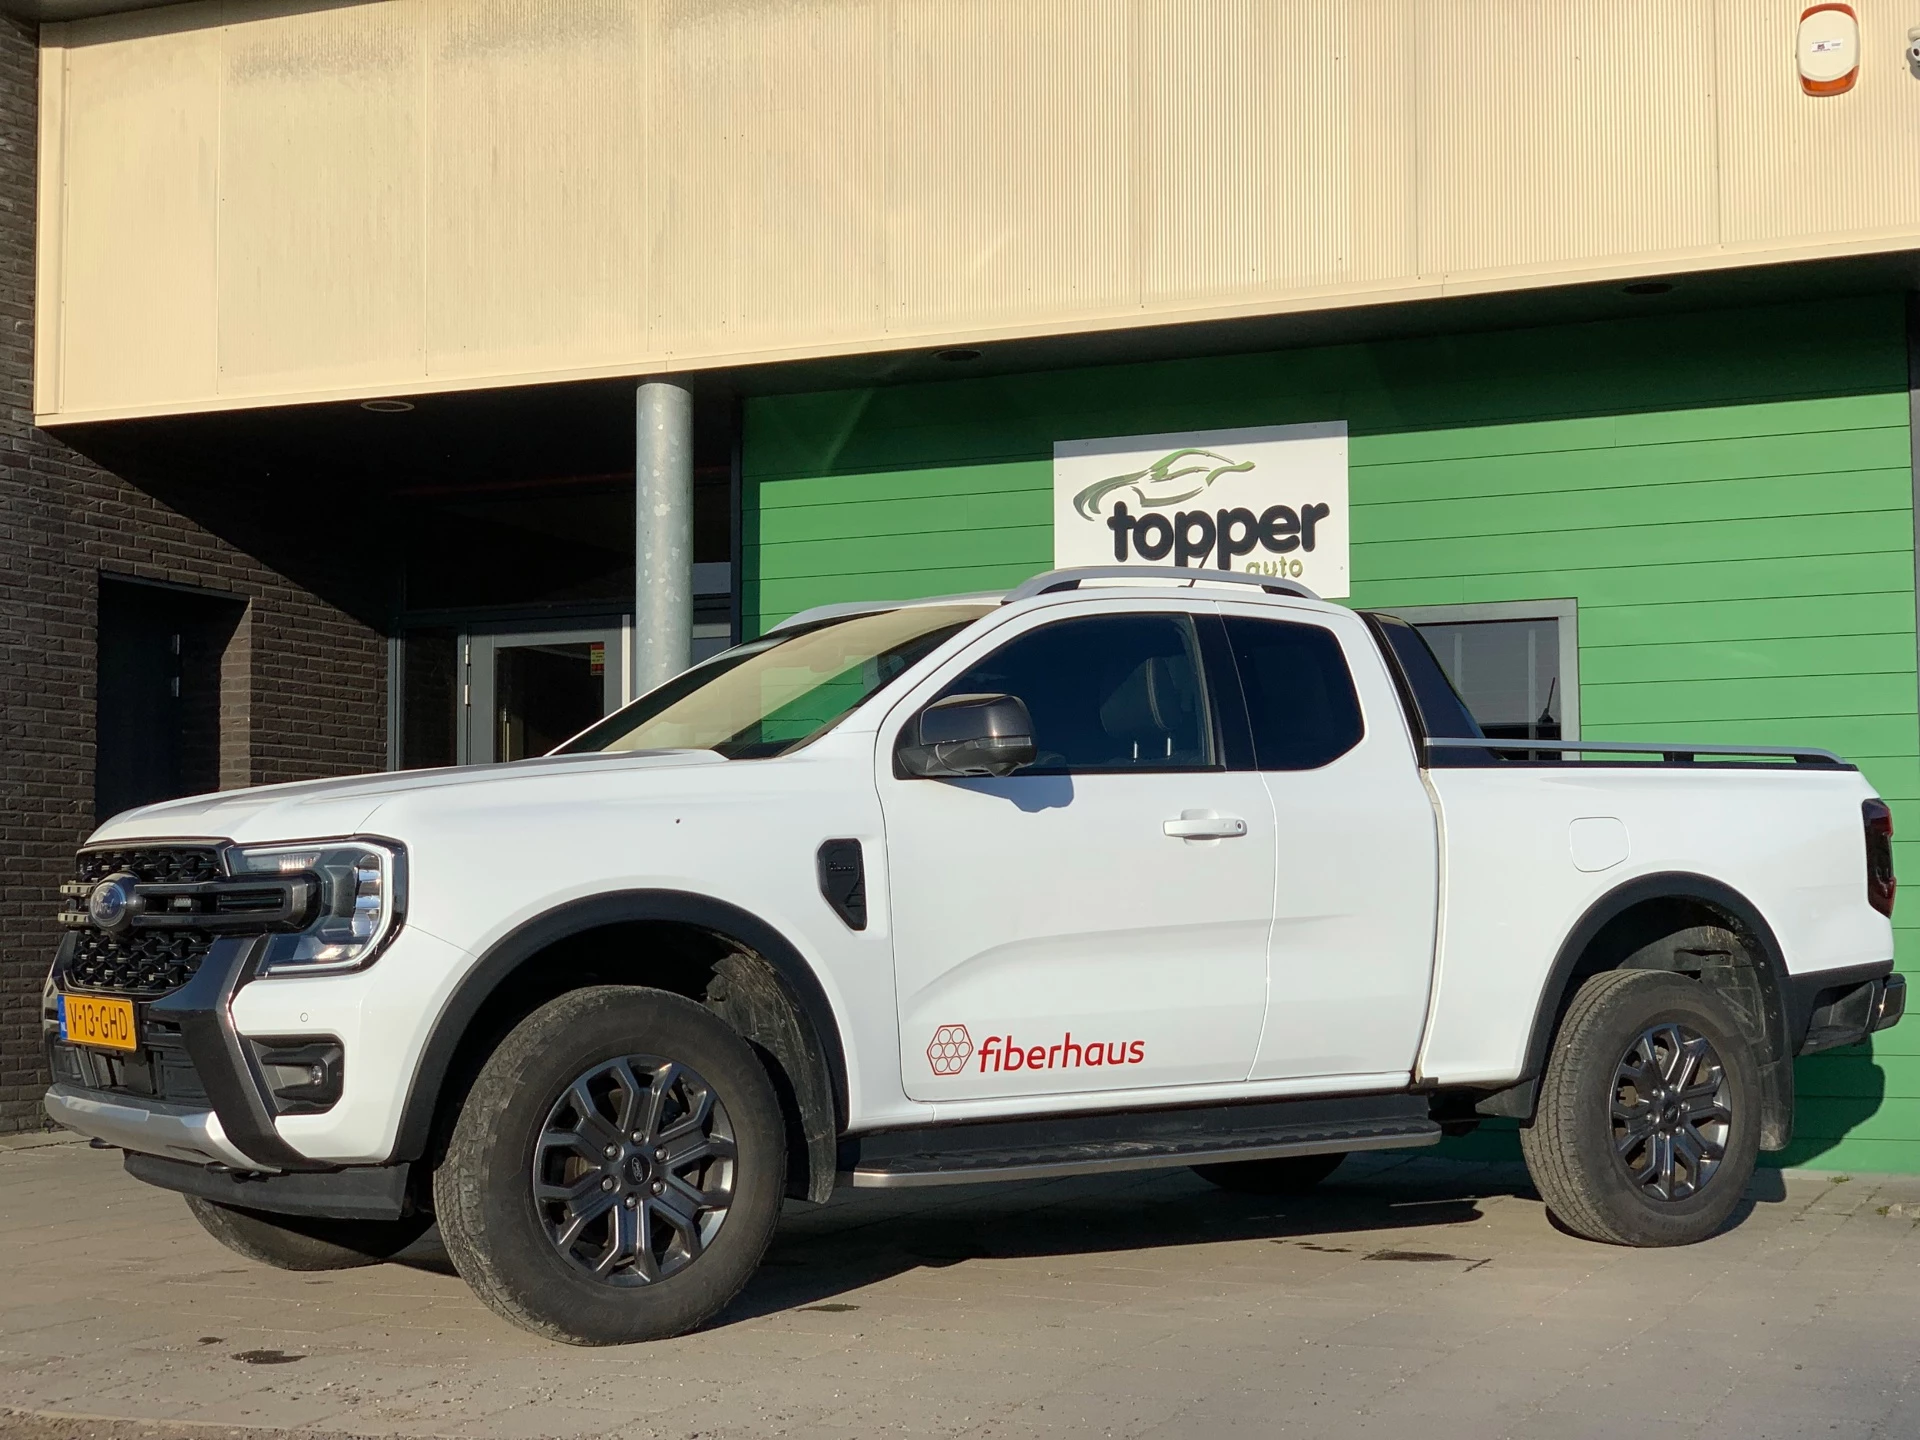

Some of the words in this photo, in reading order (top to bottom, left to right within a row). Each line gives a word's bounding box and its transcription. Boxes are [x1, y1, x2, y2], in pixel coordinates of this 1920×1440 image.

[1107, 501, 1330, 571] topper
[1245, 556, 1303, 578] auto
[69, 1003, 128, 1041] V-13-GHD
[978, 1032, 1145, 1073] fiberhaus
